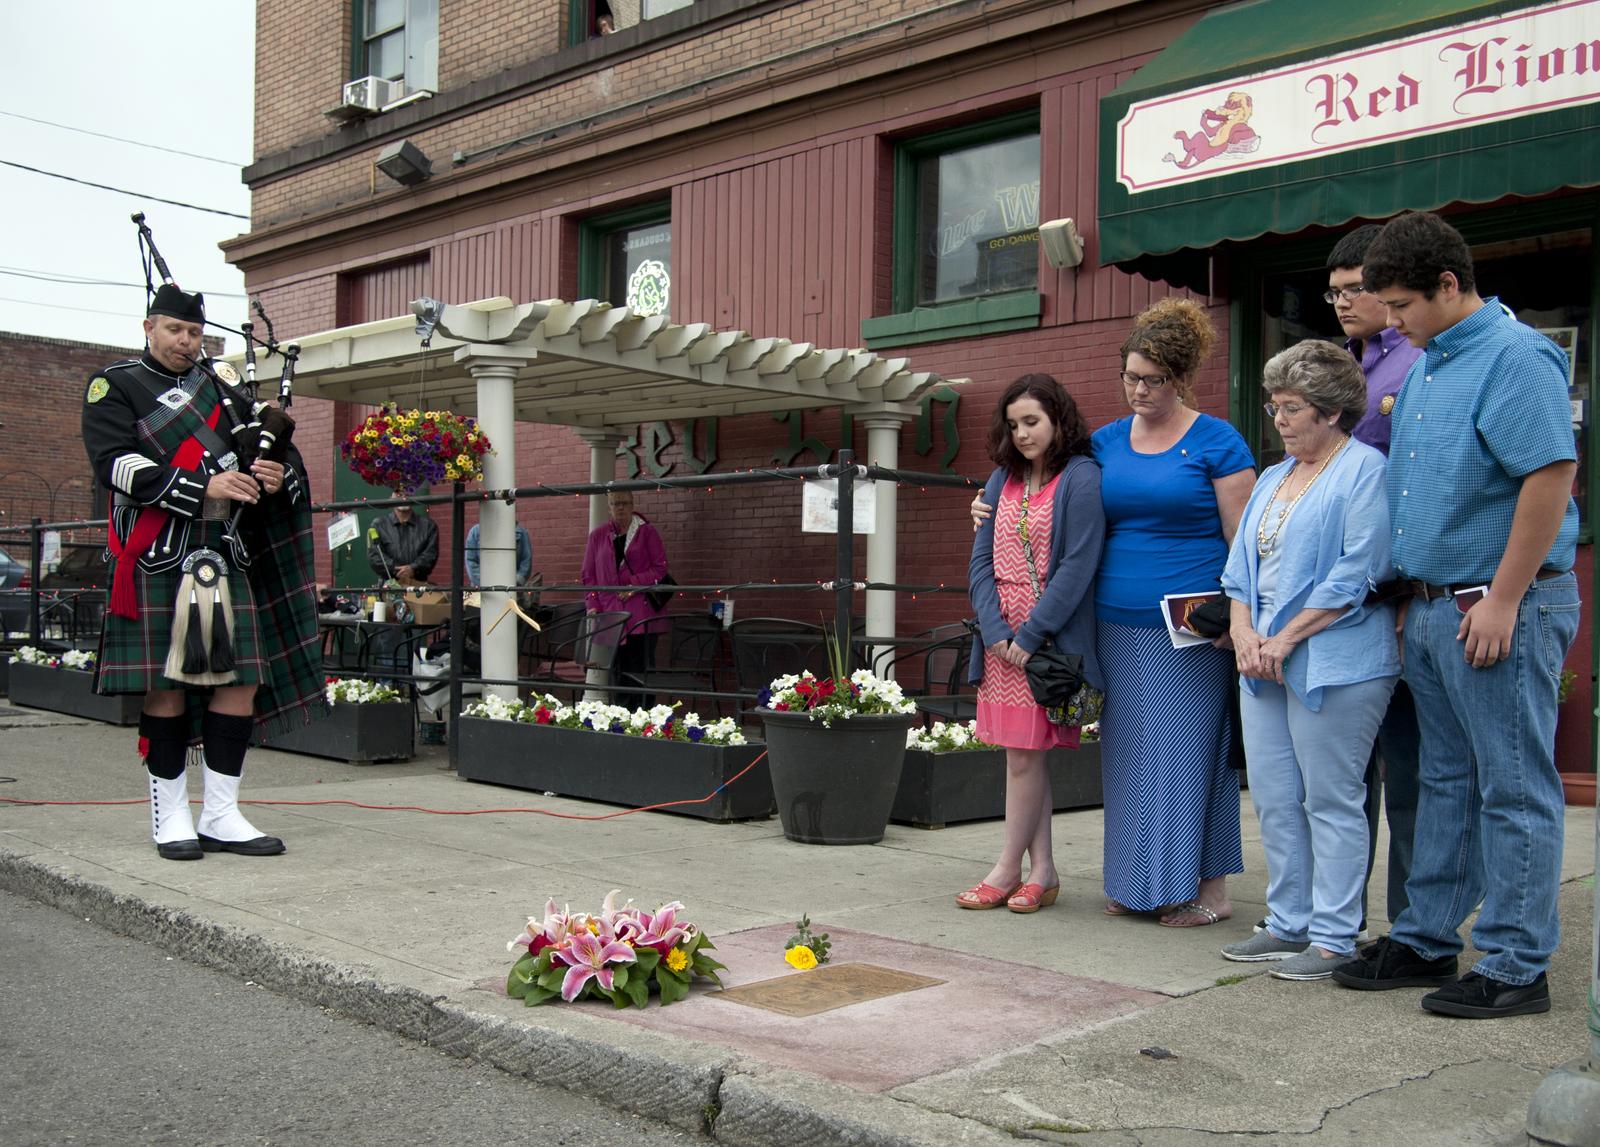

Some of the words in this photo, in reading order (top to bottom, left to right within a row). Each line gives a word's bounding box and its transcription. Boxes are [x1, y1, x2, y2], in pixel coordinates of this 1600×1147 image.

[1305, 71, 1423, 144] Red
[1438, 36, 1600, 115] Lion
[995, 180, 1040, 233] W
[989, 238, 1005, 249] GO
